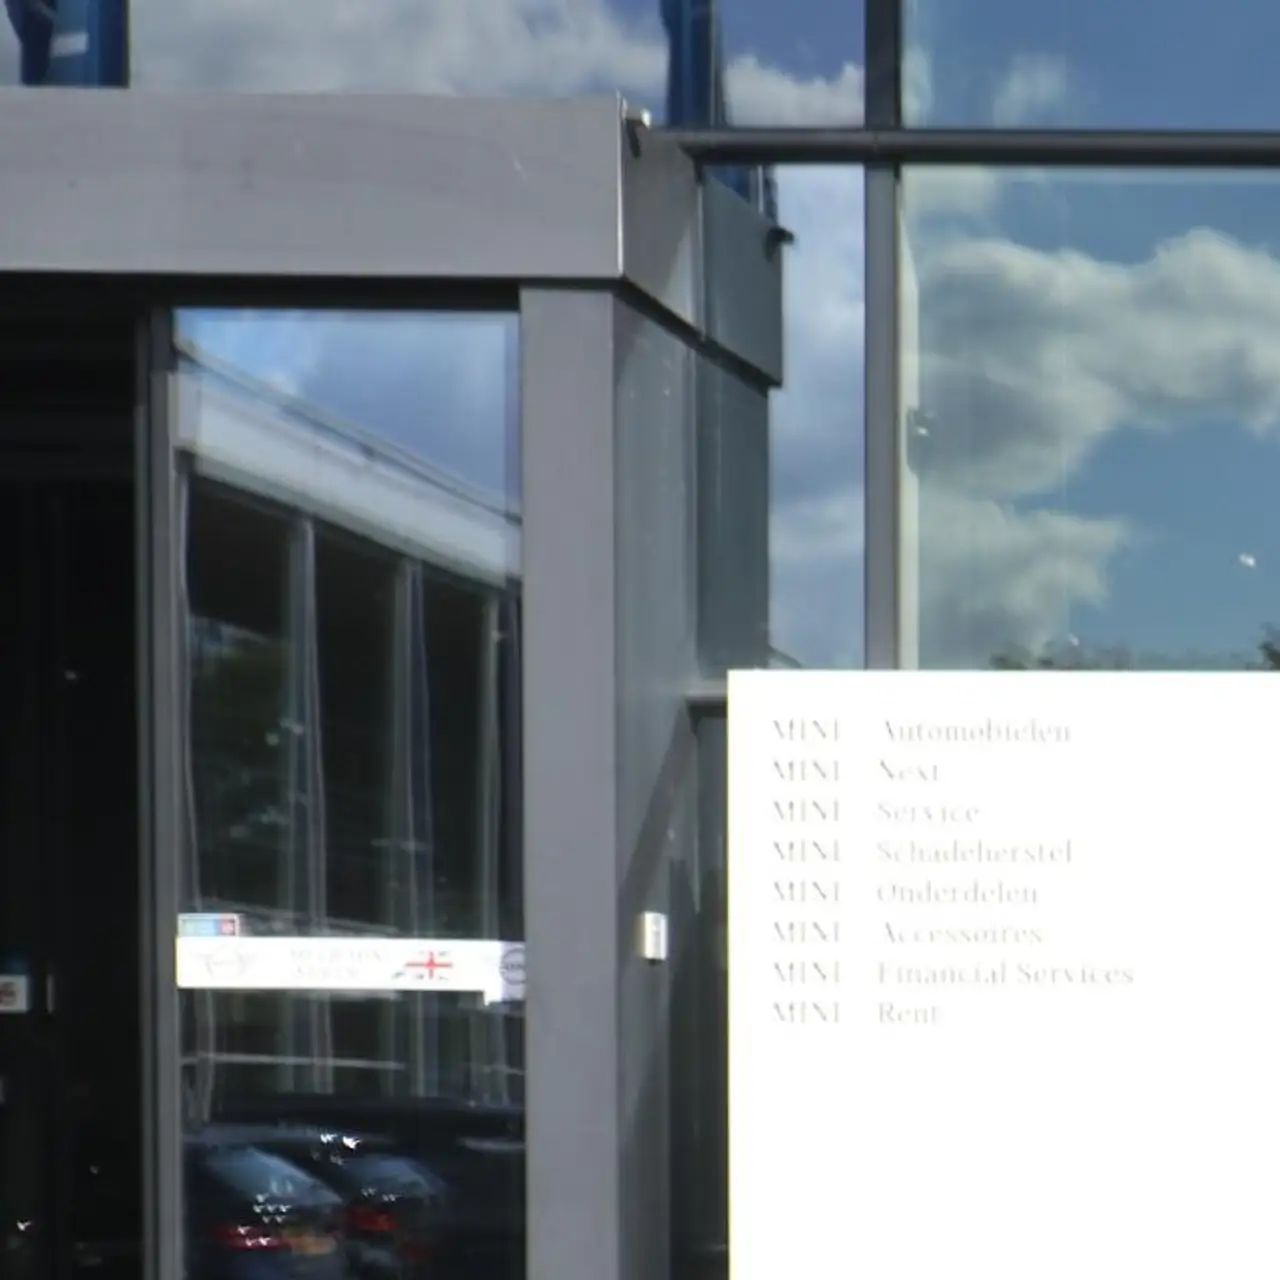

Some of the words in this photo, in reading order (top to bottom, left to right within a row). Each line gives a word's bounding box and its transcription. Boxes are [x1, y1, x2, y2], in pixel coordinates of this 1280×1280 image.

[772, 718, 840, 742] MINI
[884, 718, 1071, 742] Automobielen
[772, 759, 840, 782] MINI
[878, 759, 939, 782] Next
[772, 798, 840, 823] MINI
[877, 798, 980, 823] Service
[772, 839, 840, 864] MINI
[876, 839, 1072, 864] Schadeherstel
[772, 880, 840, 904] MINI
[876, 880, 1037, 904] Onderdelen
[772, 920, 840, 944] MINI
[884, 920, 1044, 944] Accessoires
[772, 960, 840, 985] MINI
[877, 960, 1007, 985] Financial
[1016, 960, 1134, 985] Services
[772, 1001, 840, 1024] MINI
[877, 1001, 938, 1024] Rent
